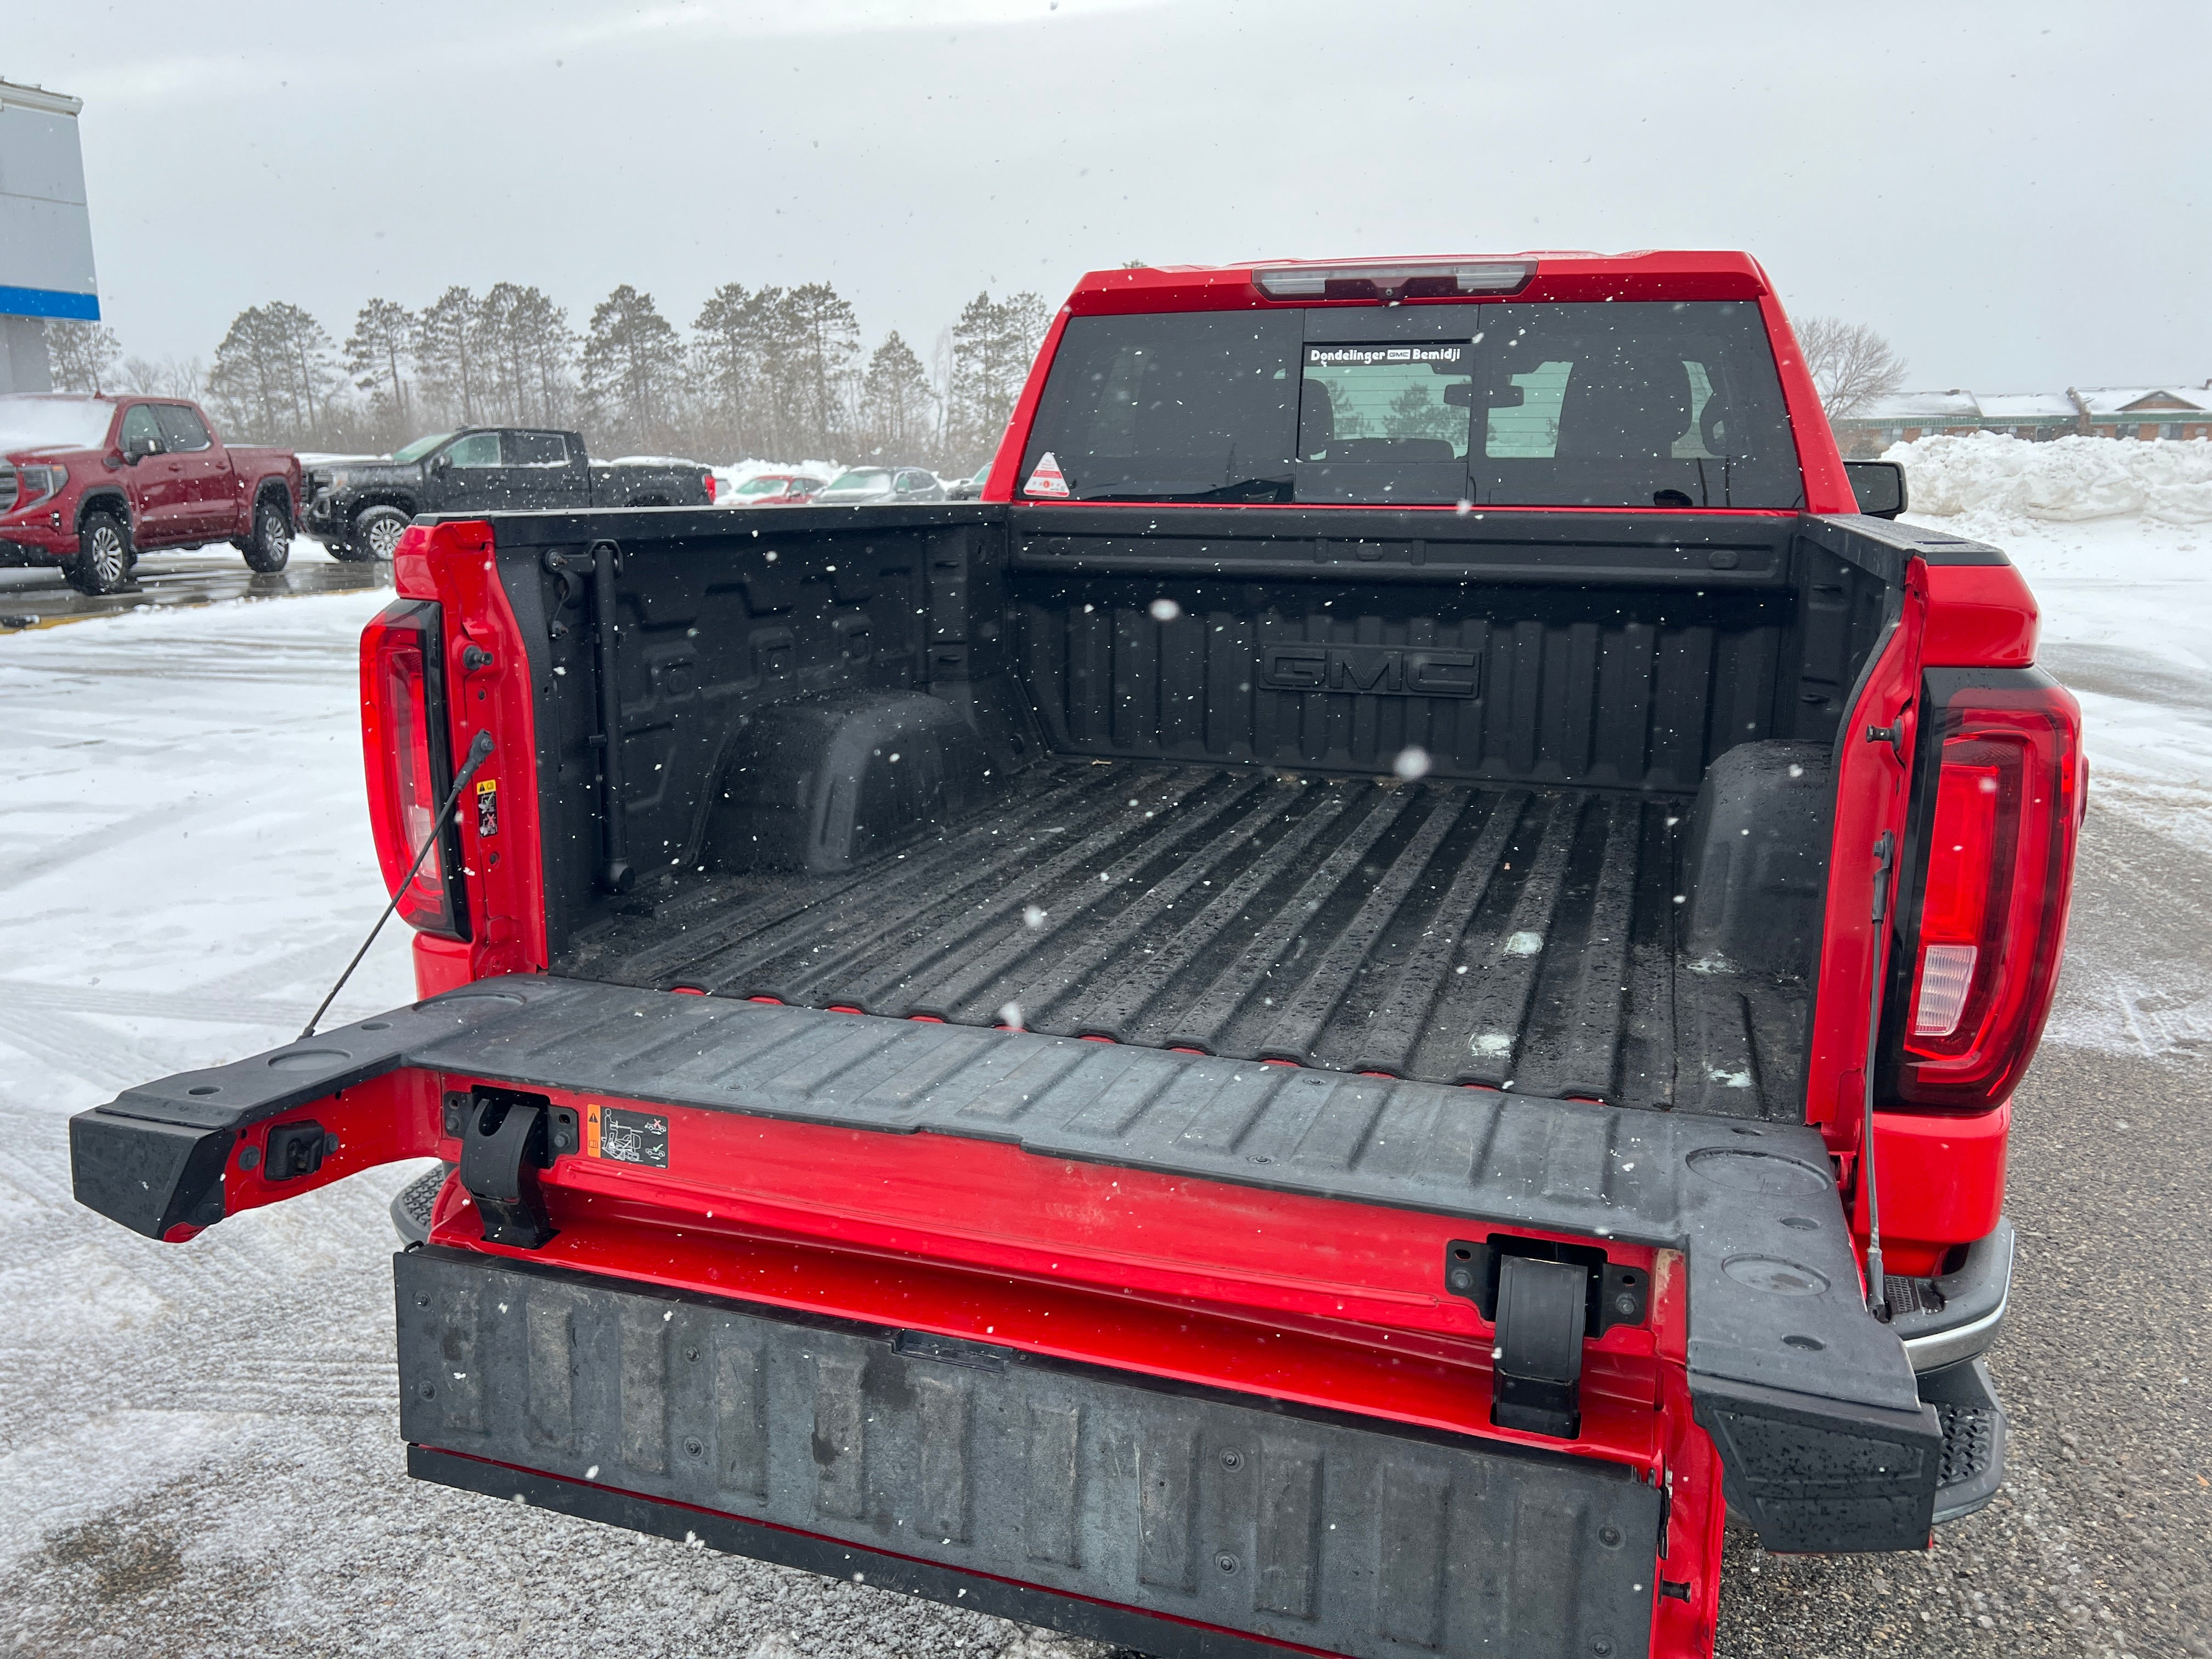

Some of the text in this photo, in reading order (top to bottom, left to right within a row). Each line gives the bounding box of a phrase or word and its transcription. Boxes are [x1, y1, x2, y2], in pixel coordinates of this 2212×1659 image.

[1311, 349, 1386, 364] Dondelinger
[1413, 348, 1460, 362] Bemidji
[1263, 647, 1475, 695] GMC
